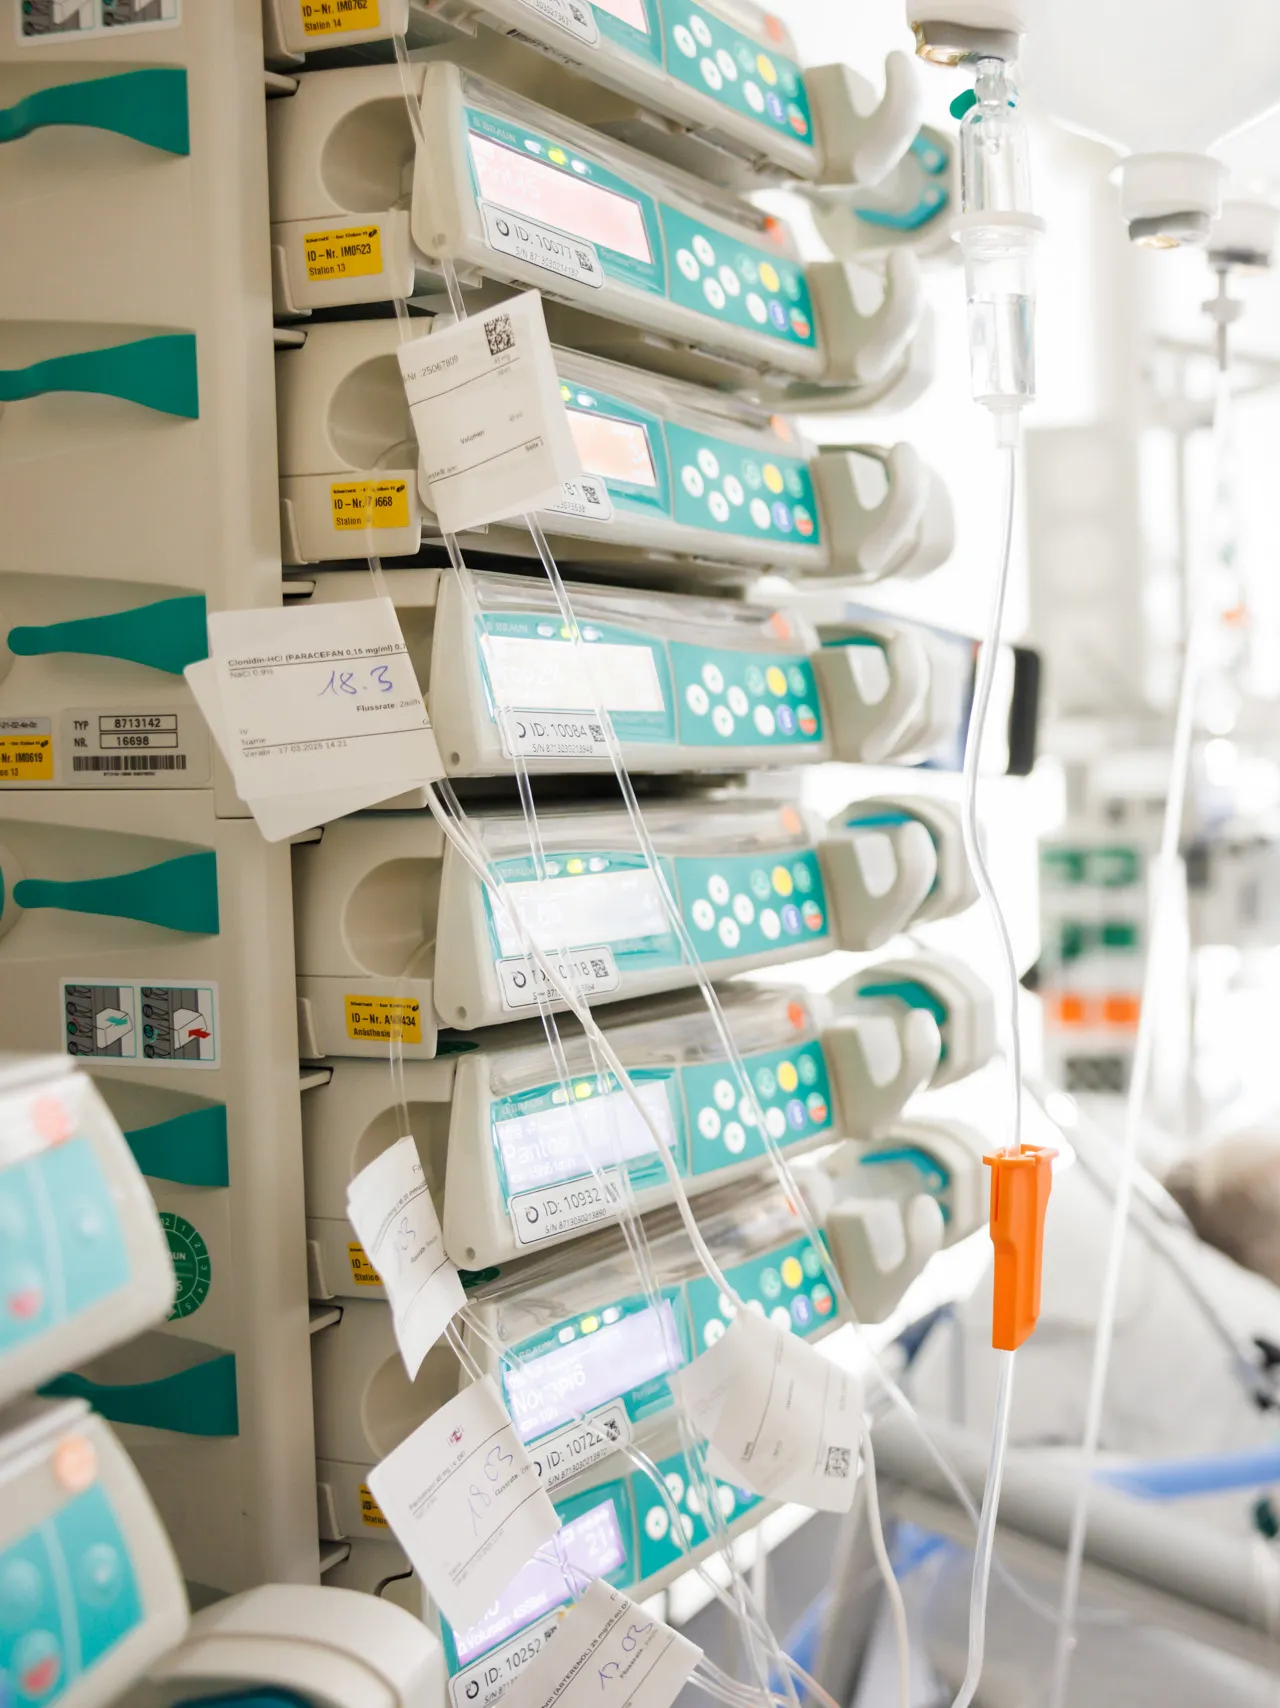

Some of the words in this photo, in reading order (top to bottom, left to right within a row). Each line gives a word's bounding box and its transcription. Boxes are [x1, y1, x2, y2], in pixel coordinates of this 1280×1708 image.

[305, 20, 331, 31] Station
[333, 18, 342, 27] 14
[341, 243, 372, 257] IM0523
[536, 234, 572, 260] 10077
[309, 265, 335, 276] Station
[337, 262, 346, 272] 13
[336, 516, 362, 526] Station
[285, 648, 344, 663] (PARACEFAN
[73, 720, 89, 730] TYP
[114, 718, 161, 729] 8713142
[529, 721, 550, 737] ID:
[550, 723, 588, 738] 10084
[73, 738, 88, 748] NR.
[116, 736, 150, 746] 16698
[10, 767, 19, 777] 13
[542, 1200, 562, 1216] ID:
[563, 1187, 602, 1211] 10932
[544, 1222, 557, 1234] S/N
[545, 1450, 565, 1470] ID:
[547, 1473, 560, 1487] S/N
[591, 1638, 600, 1649] 25
[484, 1667, 503, 1687] ID:
